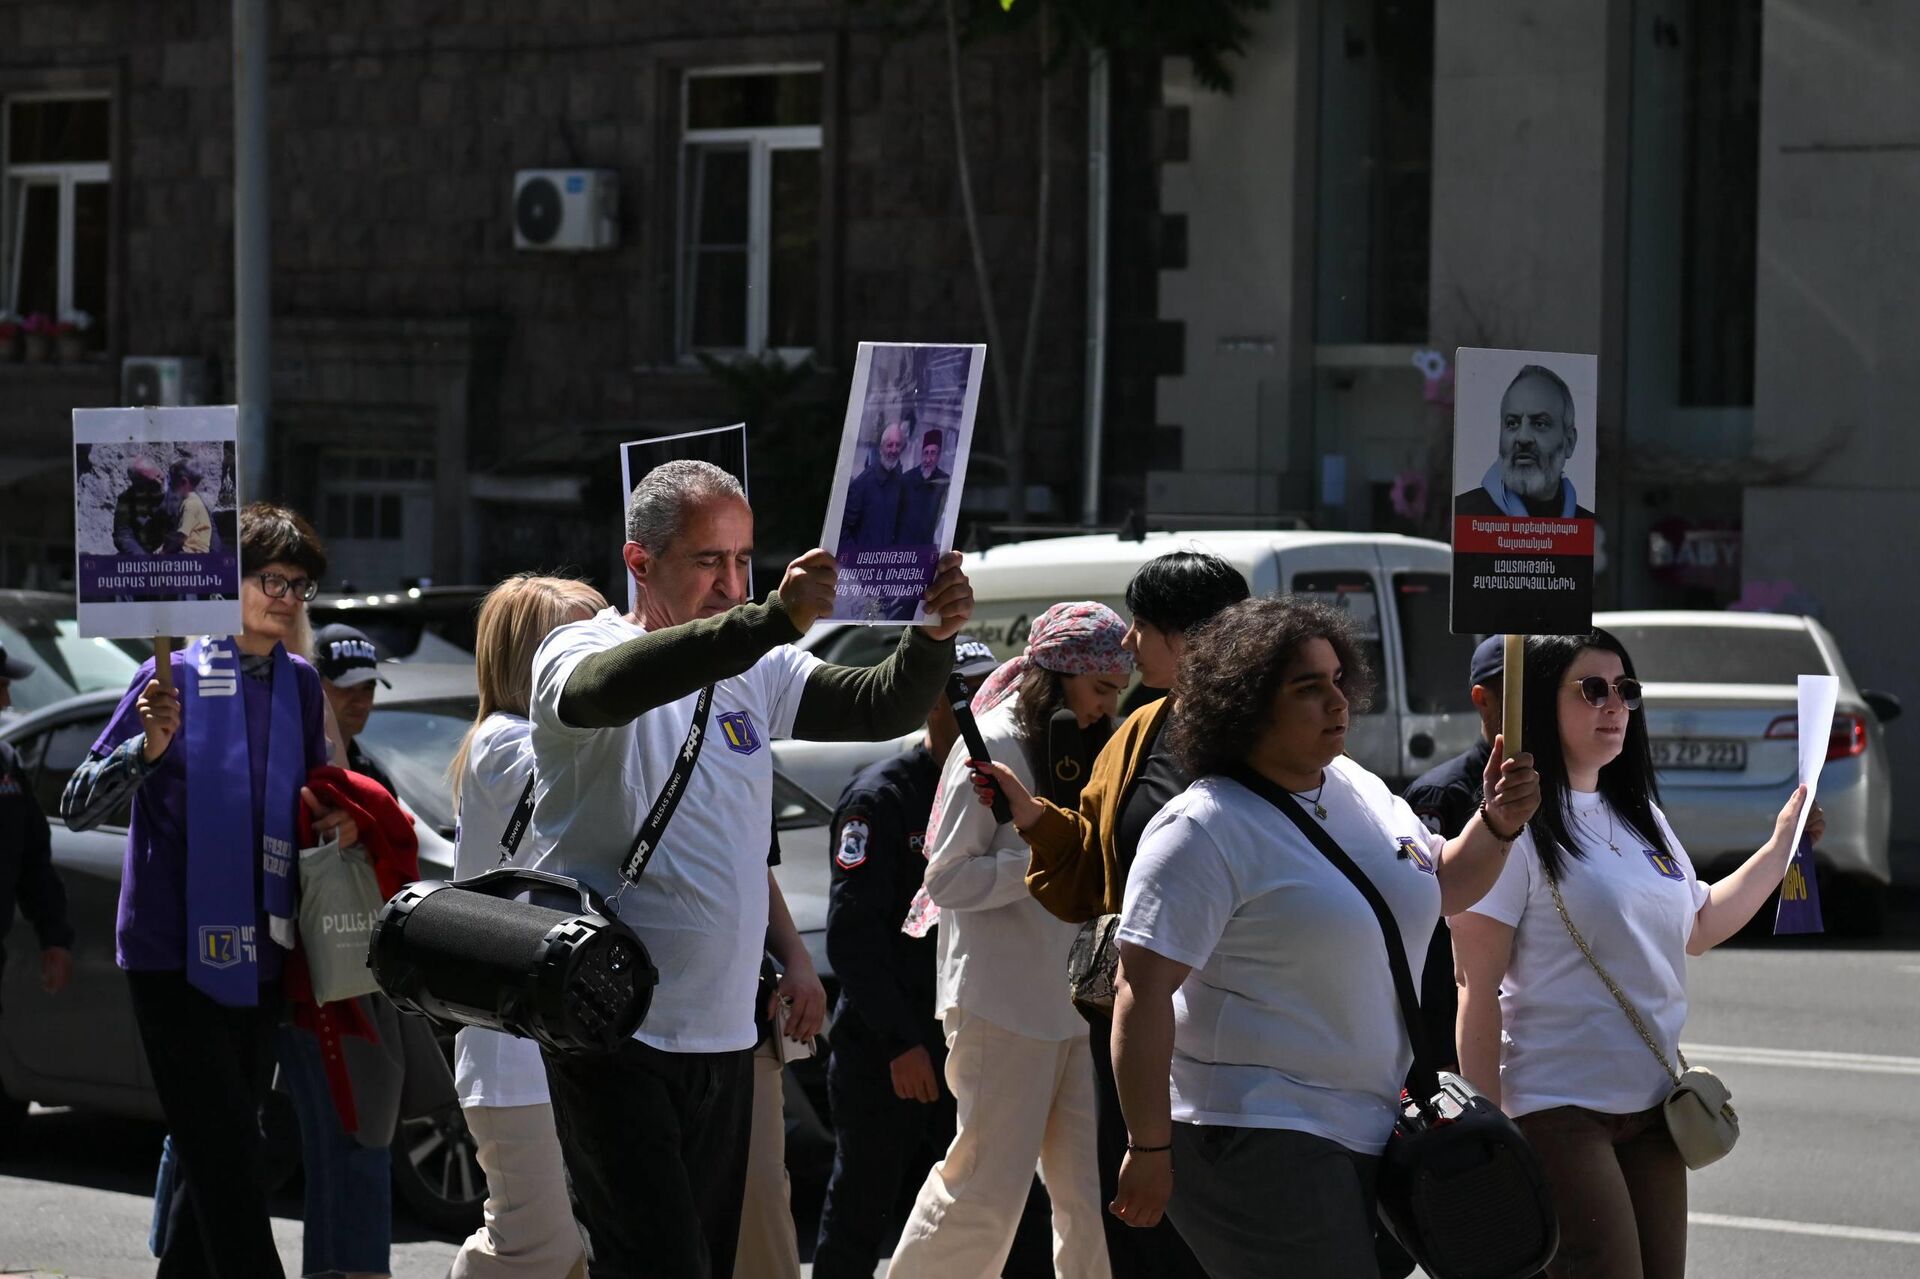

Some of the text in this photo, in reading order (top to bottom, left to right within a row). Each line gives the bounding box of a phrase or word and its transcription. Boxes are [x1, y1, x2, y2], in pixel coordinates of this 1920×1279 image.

[1472, 519, 1579, 536] Բագրատ արքեպիսկոպոս
[1497, 536, 1553, 551] Գալստանյան
[857, 551, 918, 565] ԱԶԱՏՈՒԹՅՈՒՆ
[117, 560, 202, 574] ԱԶԱՏՈՒԹՅՈՒՆ
[837, 568, 875, 580] ԲԱԳՐԱՏ
[885, 567, 925, 580] ՄԻՔԱՅԵԼ
[98, 574, 222, 589] ԲԱԳՐԱՏ ՍՐԲԱԶԱՆԻՆ
[1472, 575, 1576, 590] ՔԱՂԲԱՆՏԱՐԿՅԱԼՆԵՐԻՆ
[330, 640, 376, 660] POLICE
[682, 723, 701, 762] bbk
[669, 772, 681, 799] DANCE
[651, 798, 670, 829] SYSTEM
[507, 820, 521, 846] DANCE
[626, 839, 649, 879] bbk
